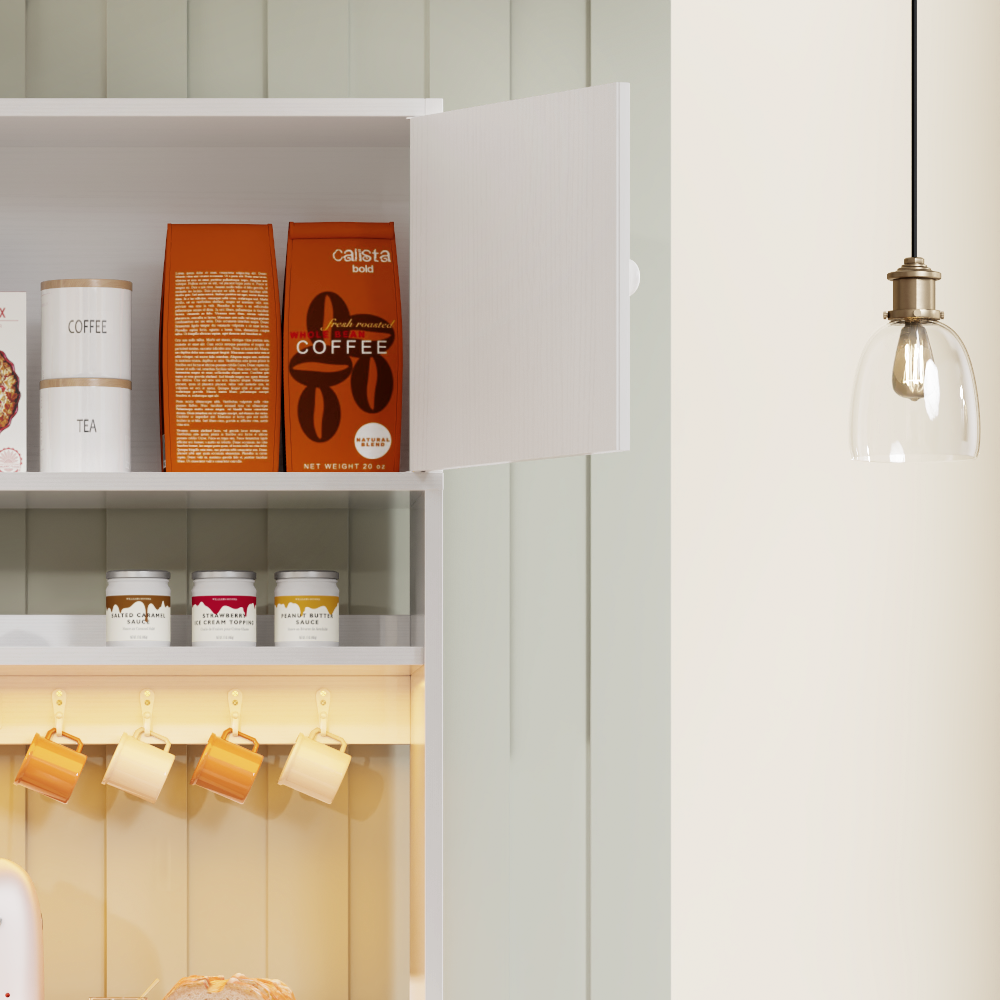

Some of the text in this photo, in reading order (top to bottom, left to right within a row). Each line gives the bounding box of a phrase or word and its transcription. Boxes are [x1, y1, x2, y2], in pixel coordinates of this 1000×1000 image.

[352, 264, 374, 273] bold
[68, 320, 107, 334] COFFEE
[320, 318, 395, 331] fresh roasted
[290, 330, 365, 339] WHOLE BEAN
[296, 339, 388, 355] COFFEE
[76, 418, 97, 433] TEA
